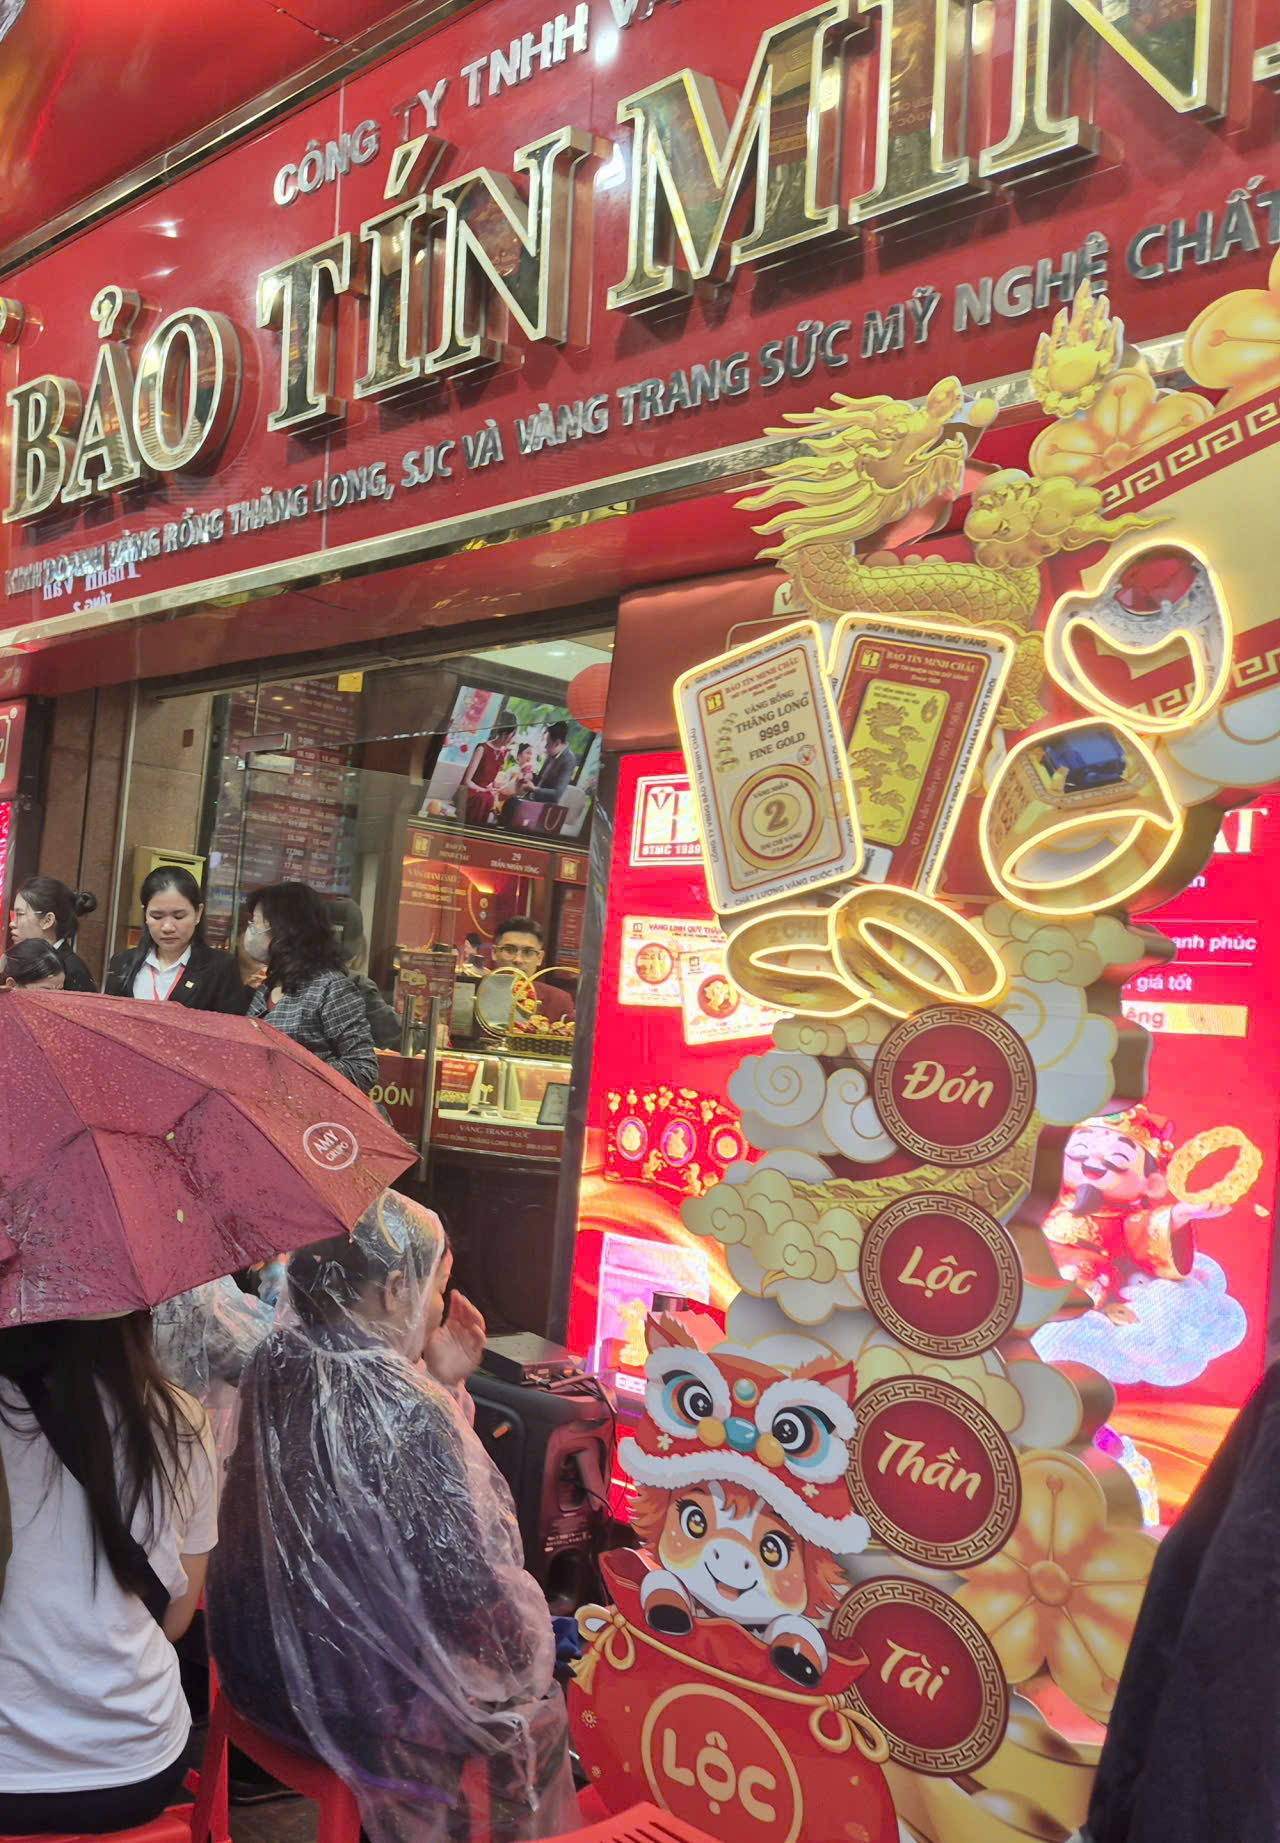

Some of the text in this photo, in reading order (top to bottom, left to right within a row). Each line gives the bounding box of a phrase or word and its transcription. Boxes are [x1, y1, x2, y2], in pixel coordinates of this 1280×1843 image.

[273, 2, 588, 207] CÔNG TY TNHH
[2, 0, 1280, 523] BẢO TÍN MIN
[5, 561, 42, 596] KINH
[108, 530, 160, 567] VÀNG
[164, 508, 224, 552] RỒNG
[228, 486, 308, 535] THĂNG
[313, 462, 394, 513] LONG,
[401, 440, 455, 487] SJC
[462, 419, 503, 469] VÀ
[514, 393, 608, 455] VÀNG
[616, 351, 749, 426] TRANG
[759, 320, 850, 387] SỨC
[860, 287, 940, 359] MỸ
[777, 696, 809, 717] LONG
[749, 732, 805, 760] FINE GOLD
[759, 720, 789, 741] 999.9
[764, 799, 789, 832] 2
[1210, 935, 1256, 952] phúc
[1137, 975, 1163, 991] giá
[369, 1081, 415, 1107] ĐÓN
[901, 1060, 993, 1109] Đón
[313, 1129, 339, 1154] AMY
[898, 1246, 978, 1297] Lộc
[877, 1430, 982, 1500] Thần
[879, 1638, 951, 1700] Tài
[661, 1728, 777, 1821] LỘC
